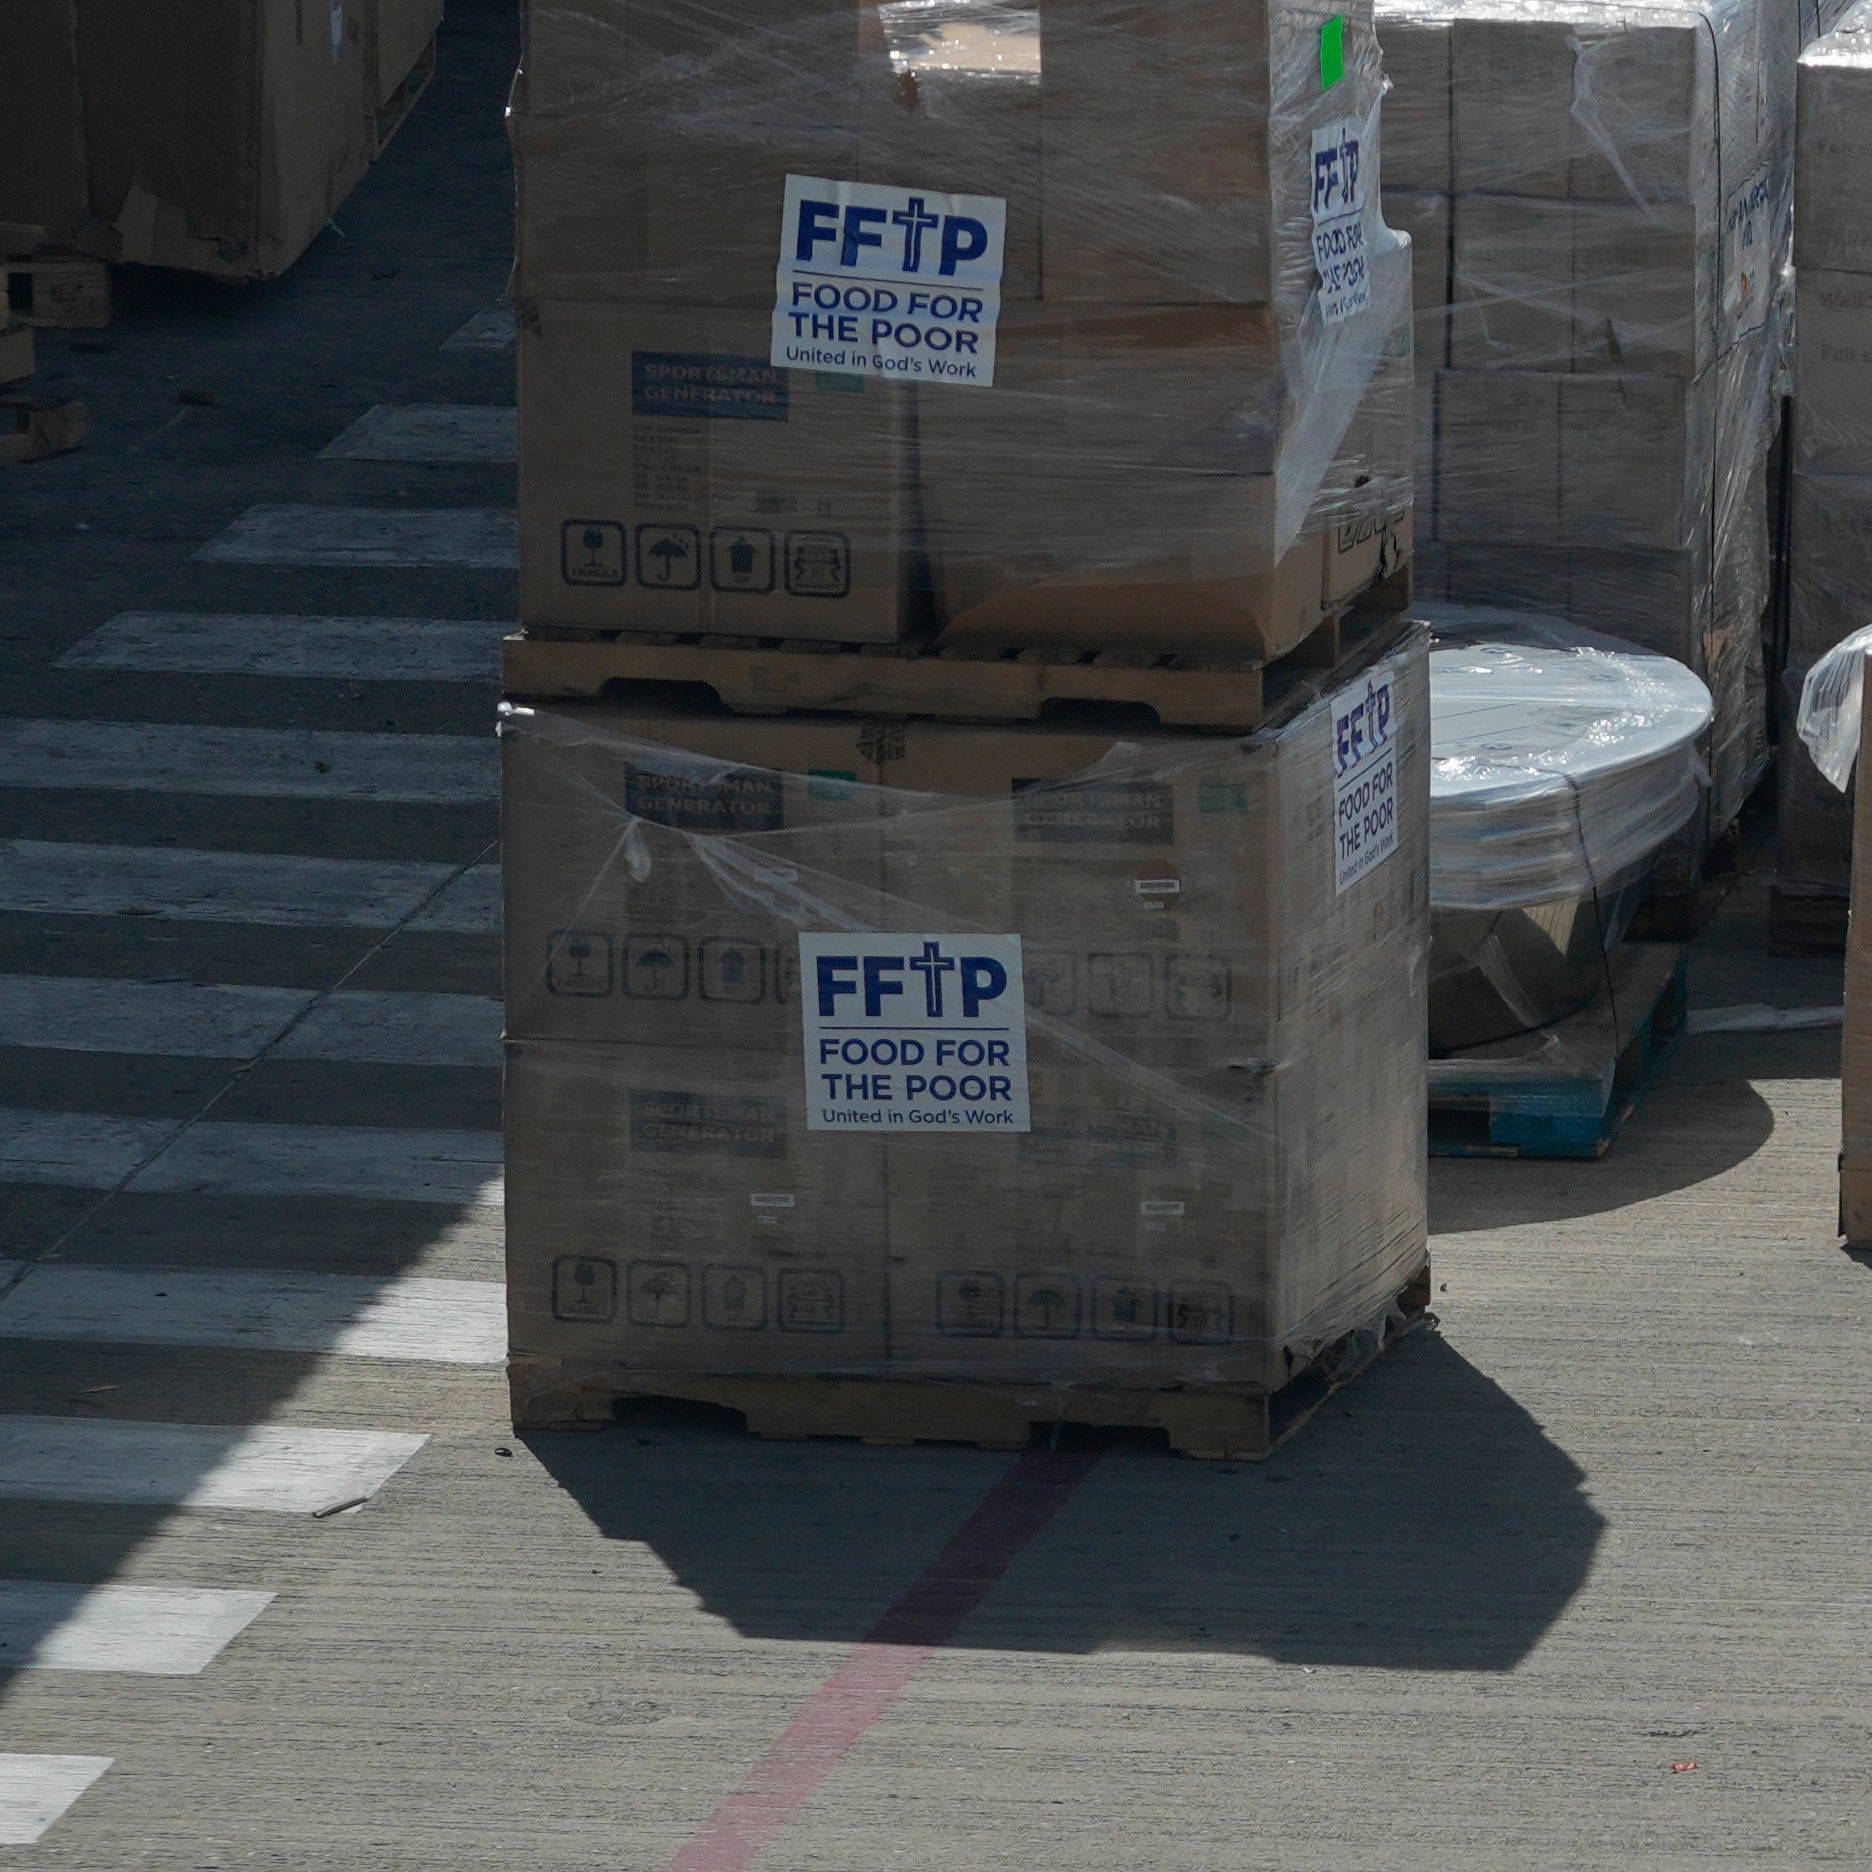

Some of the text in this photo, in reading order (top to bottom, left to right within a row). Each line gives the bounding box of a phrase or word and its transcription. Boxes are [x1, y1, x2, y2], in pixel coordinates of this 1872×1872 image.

[792, 282, 984, 323] FOOD FOR
[788, 311, 979, 354] THE POOR
[644, 364, 778, 384] SPORTSMAN
[786, 345, 977, 378] United in God's Work
[644, 384, 779, 406] GENERATOR
[637, 796, 771, 818] GENERATOR
[1338, 761, 1393, 827] FOOD FOR
[1339, 796, 1394, 860] THE POOR
[819, 1038, 1010, 1067] FOOD FOR
[821, 1073, 1012, 1101] THE POOR
[823, 1108, 1014, 1125] United in God's Work
